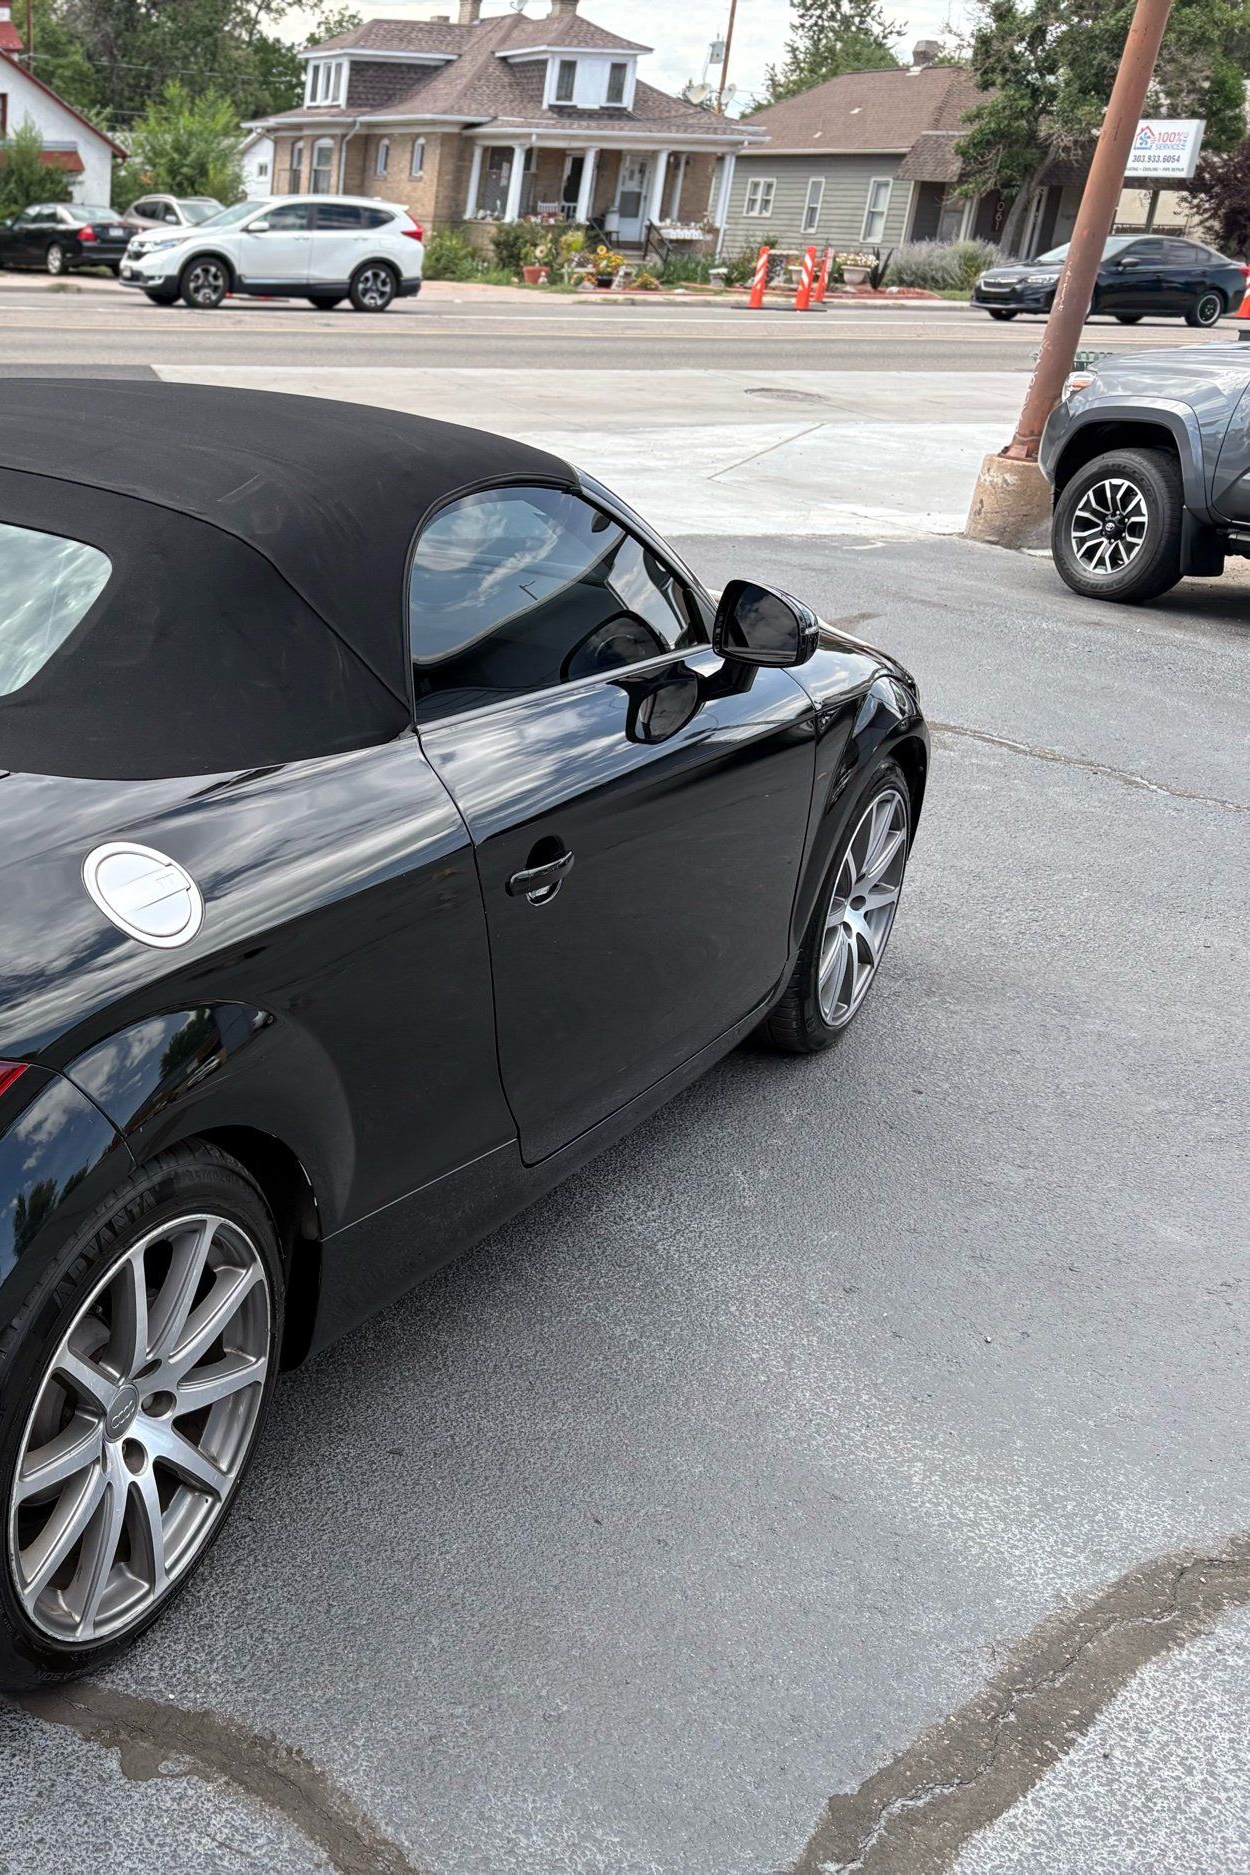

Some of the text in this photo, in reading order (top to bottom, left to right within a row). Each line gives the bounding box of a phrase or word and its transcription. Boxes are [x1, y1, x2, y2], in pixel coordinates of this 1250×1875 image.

[1157, 131, 1183, 143] 100%
[1155, 143, 1181, 151] SERVICE
[1132, 155, 1181, 163] 303.933.6054
[52, 1188, 158, 1308] ADVANTA
